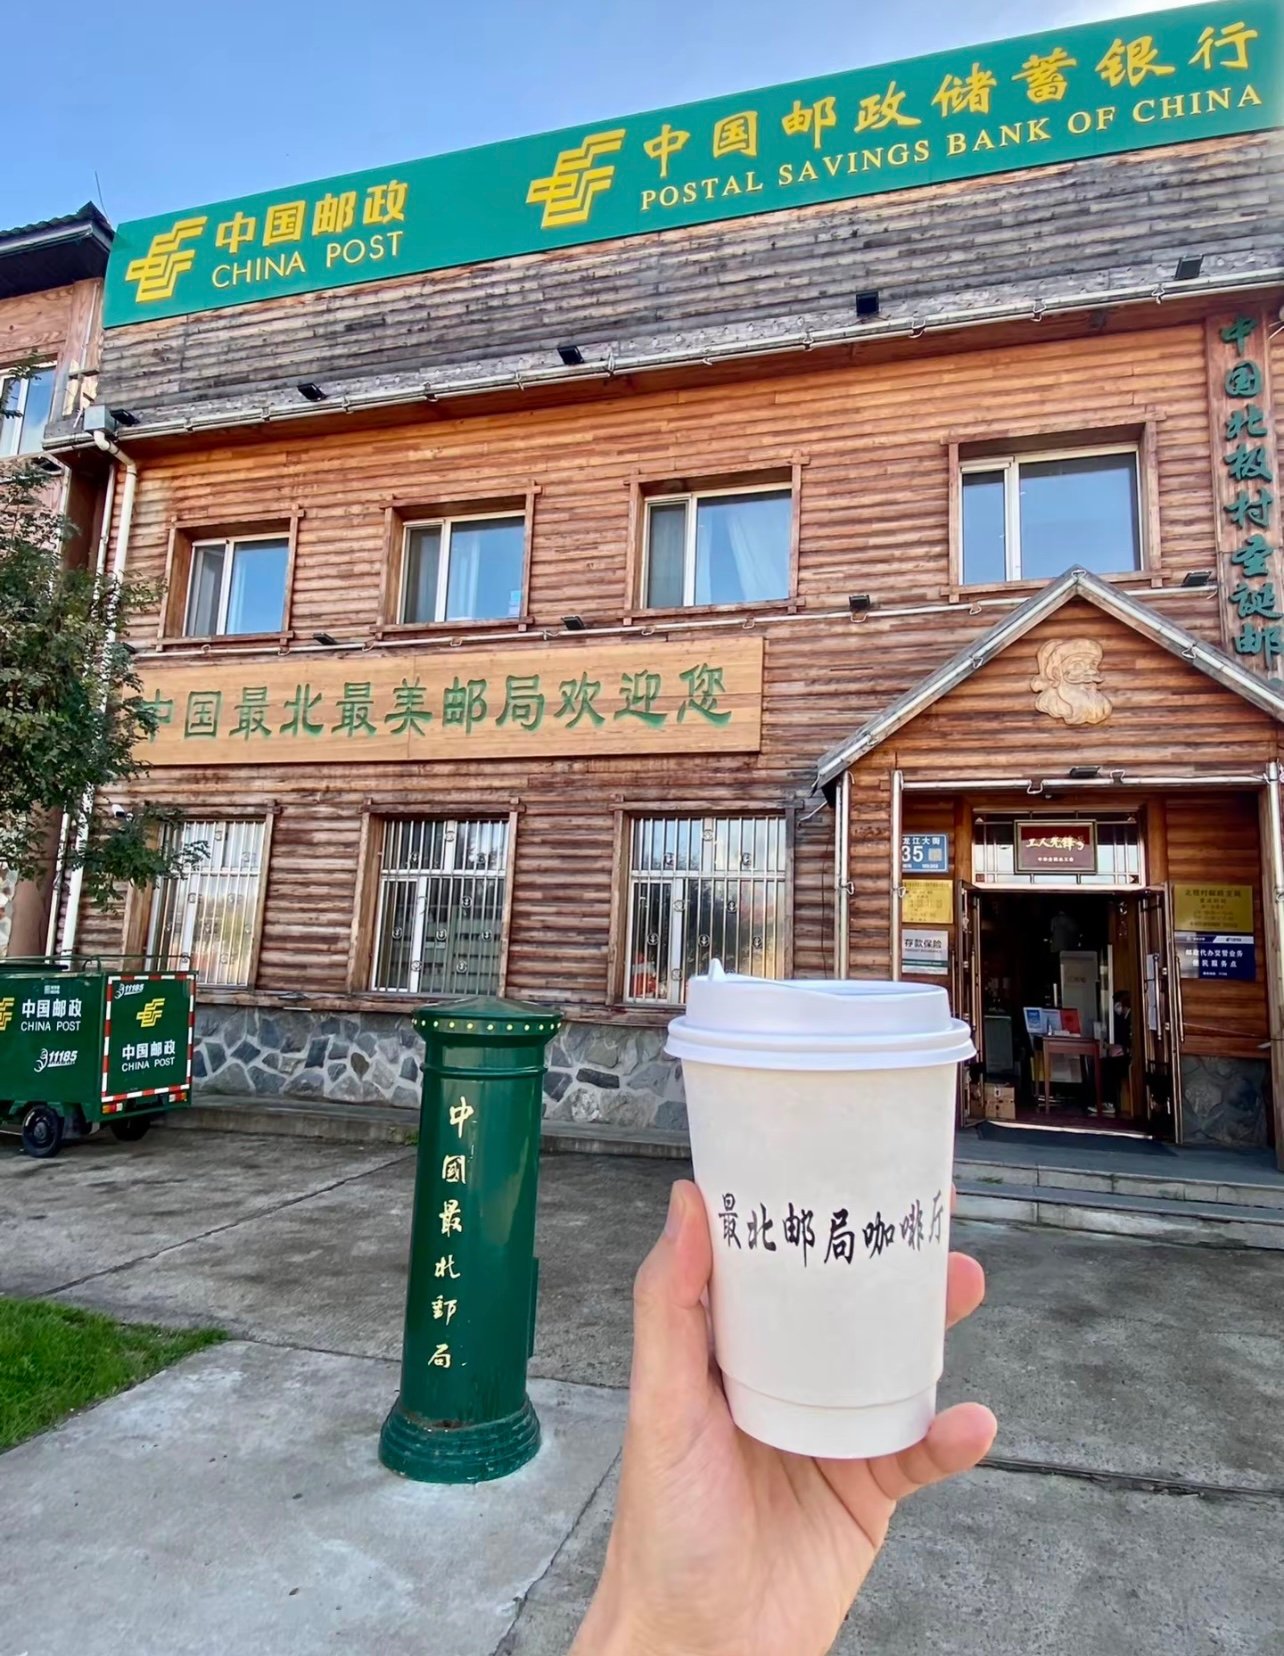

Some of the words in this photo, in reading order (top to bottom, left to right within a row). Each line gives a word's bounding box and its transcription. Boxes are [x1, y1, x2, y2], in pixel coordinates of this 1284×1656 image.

[642, 21, 1259, 180] 中国邮政储蓄银行
[640, 171, 763, 212] POSTAL
[777, 138, 930, 187] SAVINGS
[946, 118, 1052, 157] BANK
[1067, 106, 1117, 135] OF
[1132, 84, 1263, 125] CHINA
[215, 179, 408, 254] 中国邮政
[211, 250, 306, 289] CHINA
[326, 231, 404, 268] POST
[1220, 314, 1284, 684] 中国北极村圣诞邮
[138, 662, 732, 742] 中国最北最美邮局欢迎您
[901, 845, 924, 862] 35
[1192, 959, 1237, 968] 民服务点
[20, 1021, 51, 1032] CHINA
[56, 1021, 81, 1032] POST
[22, 998, 82, 1018] 中国邮政
[48, 1050, 78, 1062] 11185
[121, 1060, 150, 1072] CHINA
[154, 1057, 175, 1067] POST
[122, 1039, 176, 1060] 中国邮政
[718, 1189, 944, 1268] 最北邮局咖啡厅
